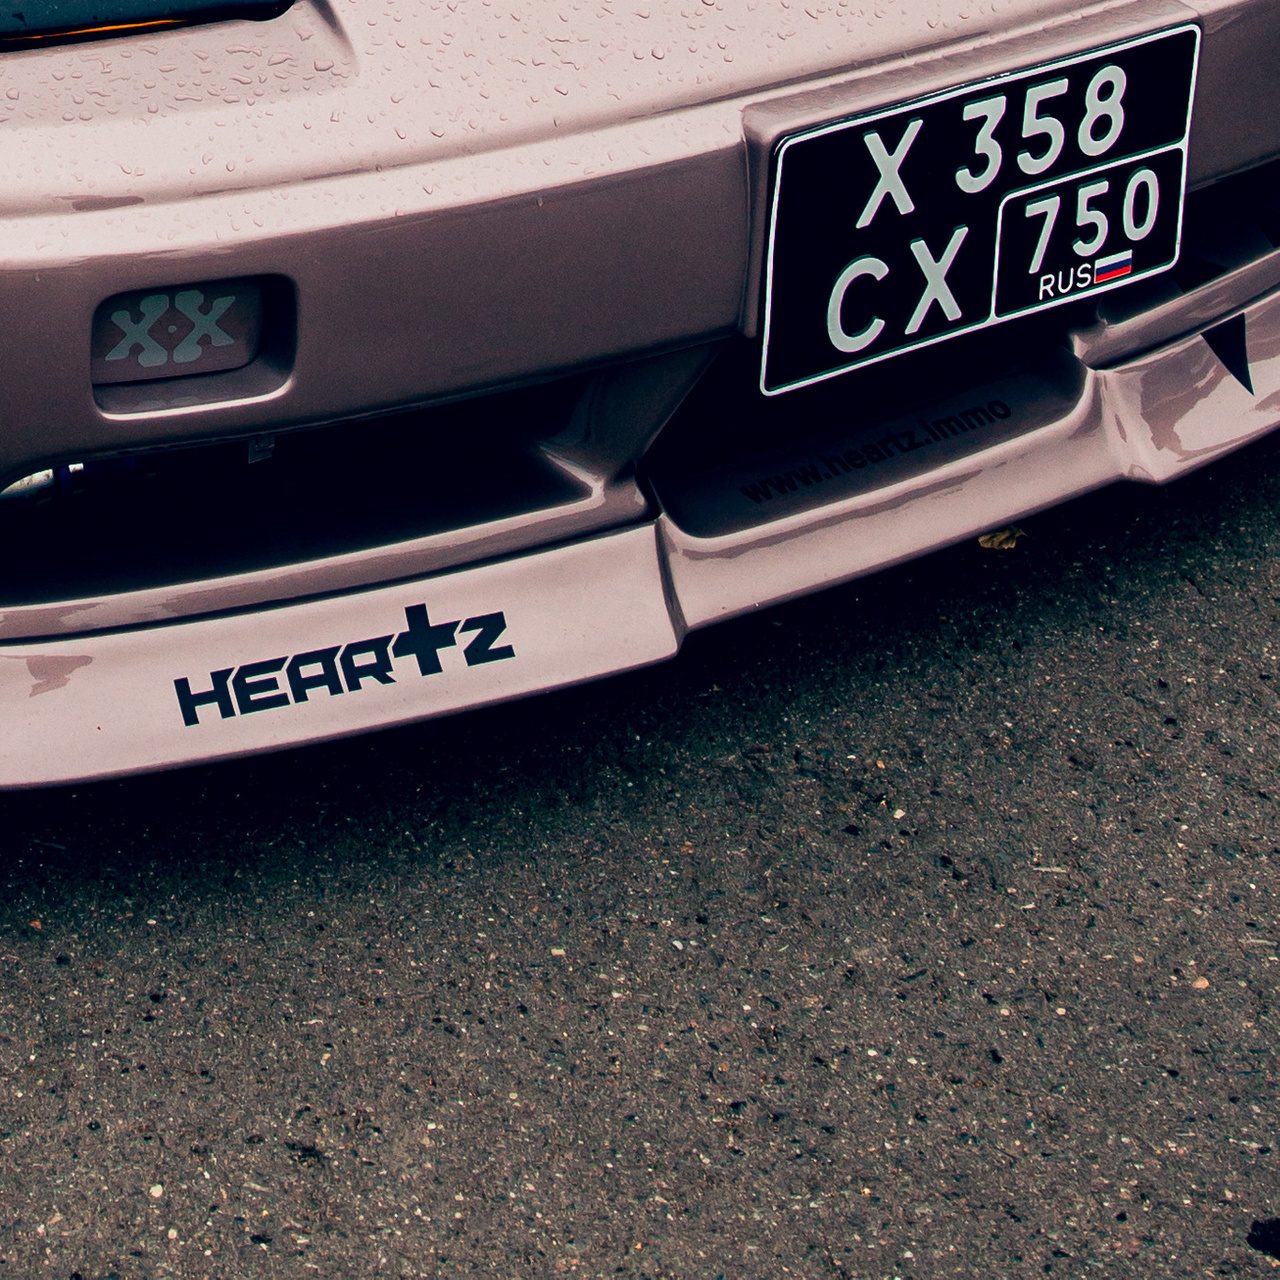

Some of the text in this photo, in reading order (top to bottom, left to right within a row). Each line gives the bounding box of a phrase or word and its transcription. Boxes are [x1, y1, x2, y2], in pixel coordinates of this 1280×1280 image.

[856, 64, 1127, 230] X 358
[1024, 168, 1160, 275] 750
[826, 226, 969, 353] CX
[1039, 262, 1092, 301] RUS
[739, 398, 1012, 505] www.heartz.immo
